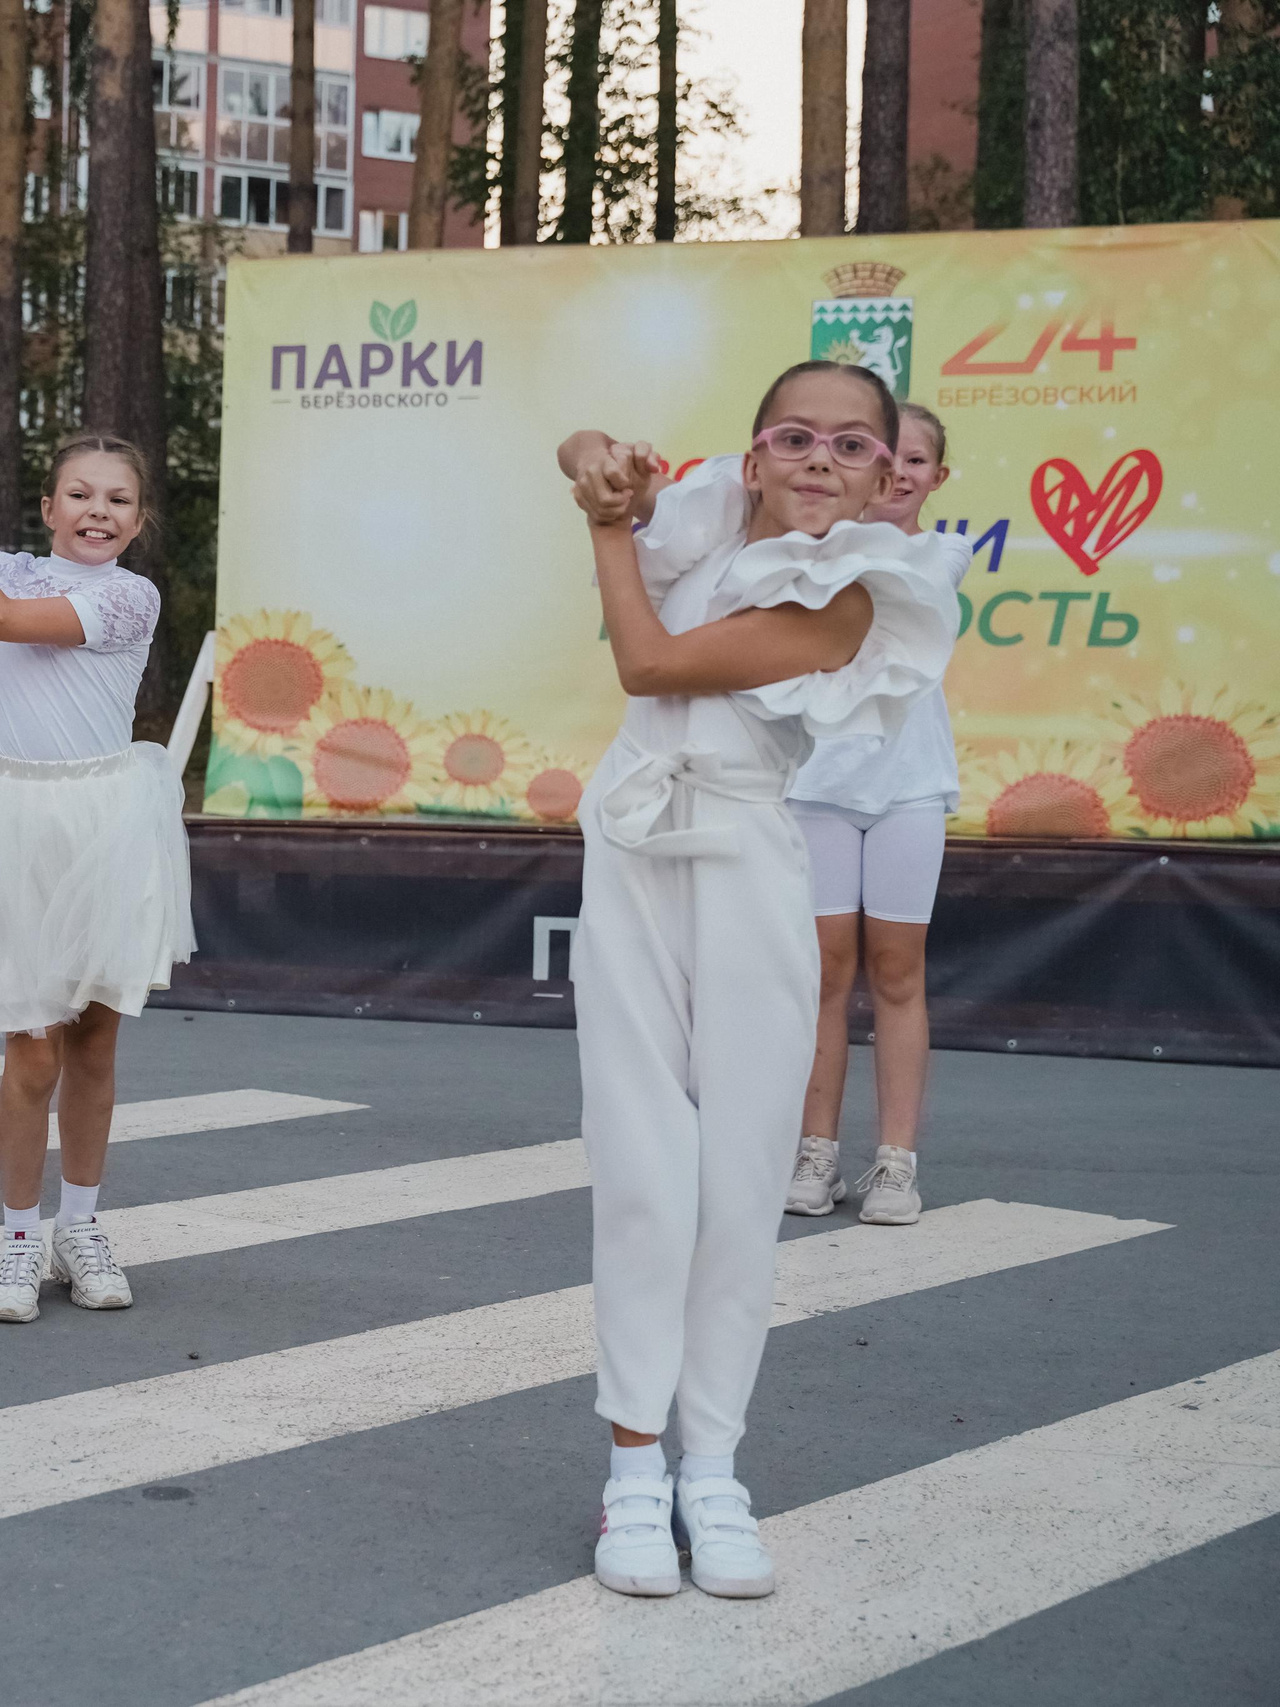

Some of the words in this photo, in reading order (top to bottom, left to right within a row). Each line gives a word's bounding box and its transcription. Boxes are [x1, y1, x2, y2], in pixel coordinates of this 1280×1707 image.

[271, 339, 483, 391] ПАРКИ
[300, 391, 449, 410] БЕРЁЗОВСКОГО
[937, 380, 1138, 408] БЕРЁЗОВСКИЙ
